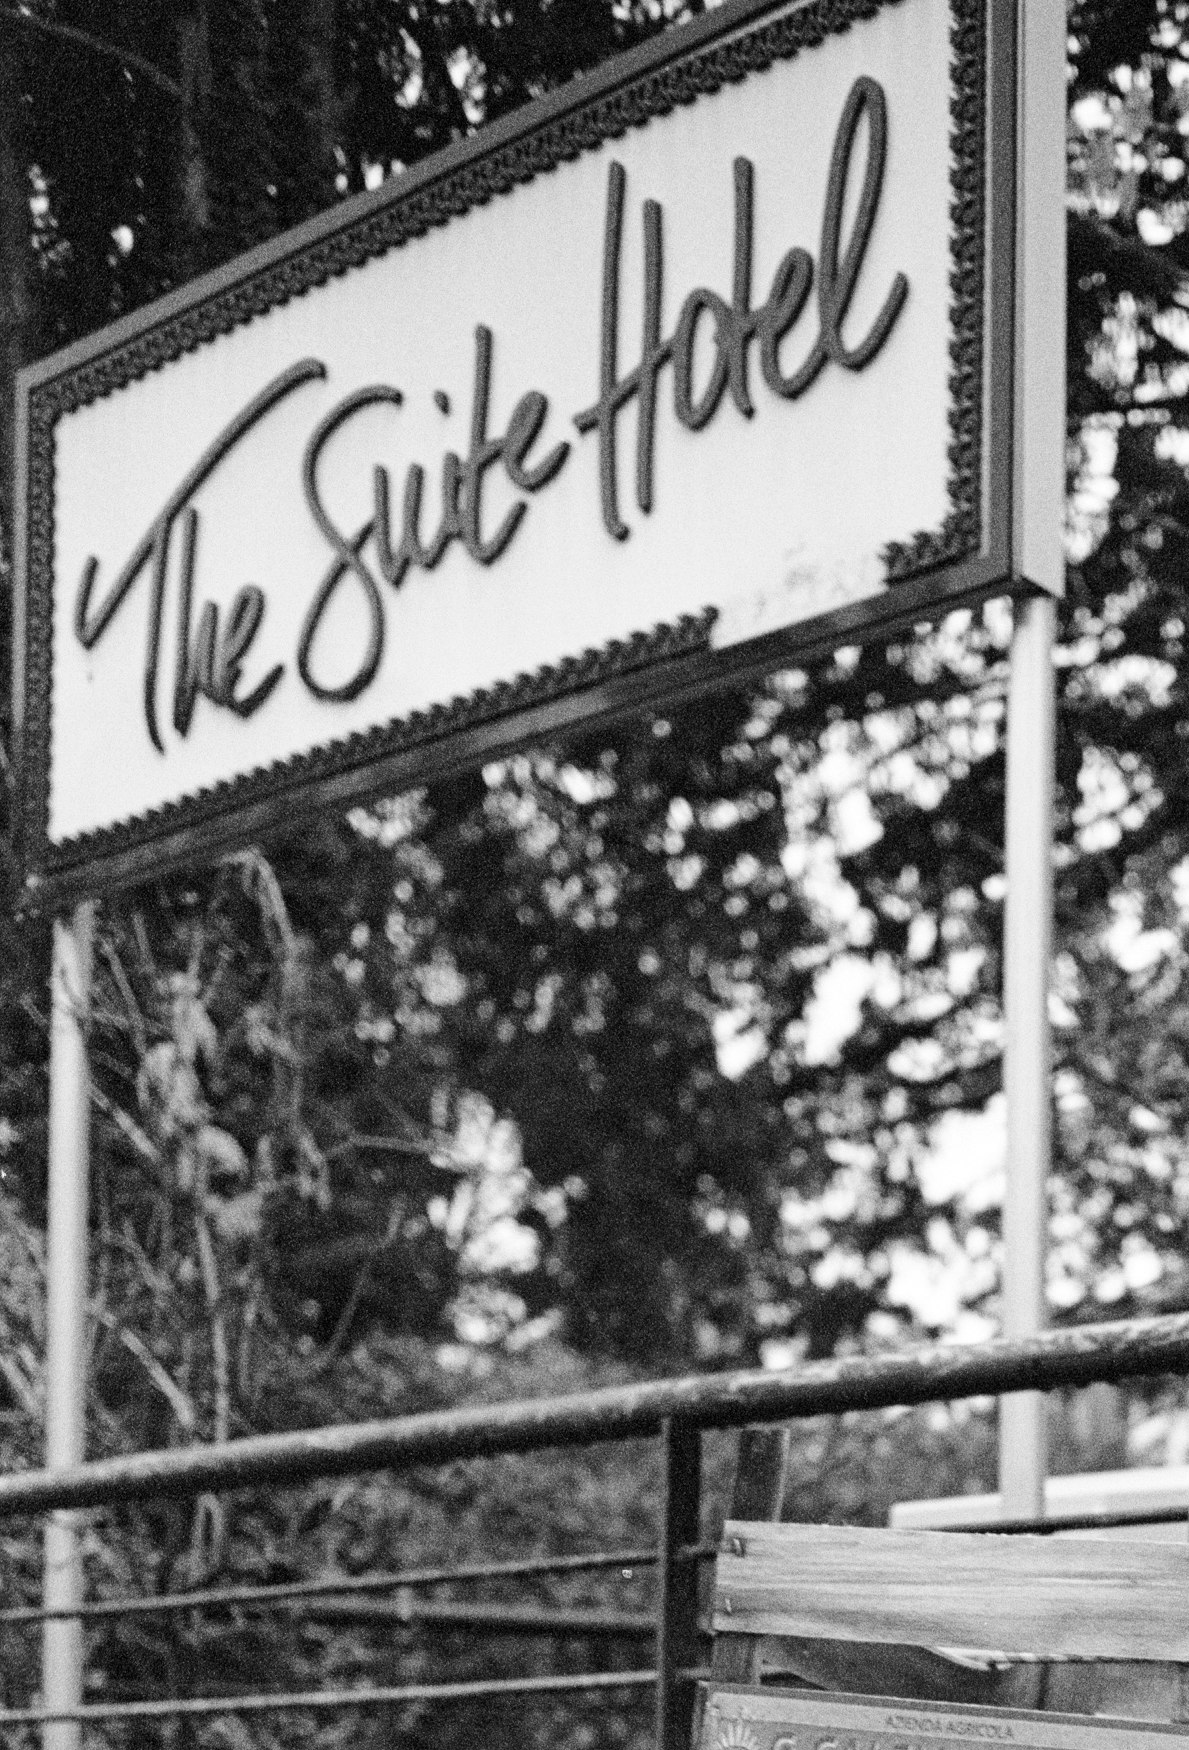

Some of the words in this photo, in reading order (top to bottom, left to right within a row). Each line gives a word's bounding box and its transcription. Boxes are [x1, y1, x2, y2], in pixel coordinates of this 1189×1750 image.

[75, 357, 328, 756] The
[298, 323, 571, 702] Suite
[574, 75, 908, 542] Hotel
[884, 1715, 943, 1733] AZIENDA
[944, 1720, 1015, 1740] AGRICOLA
